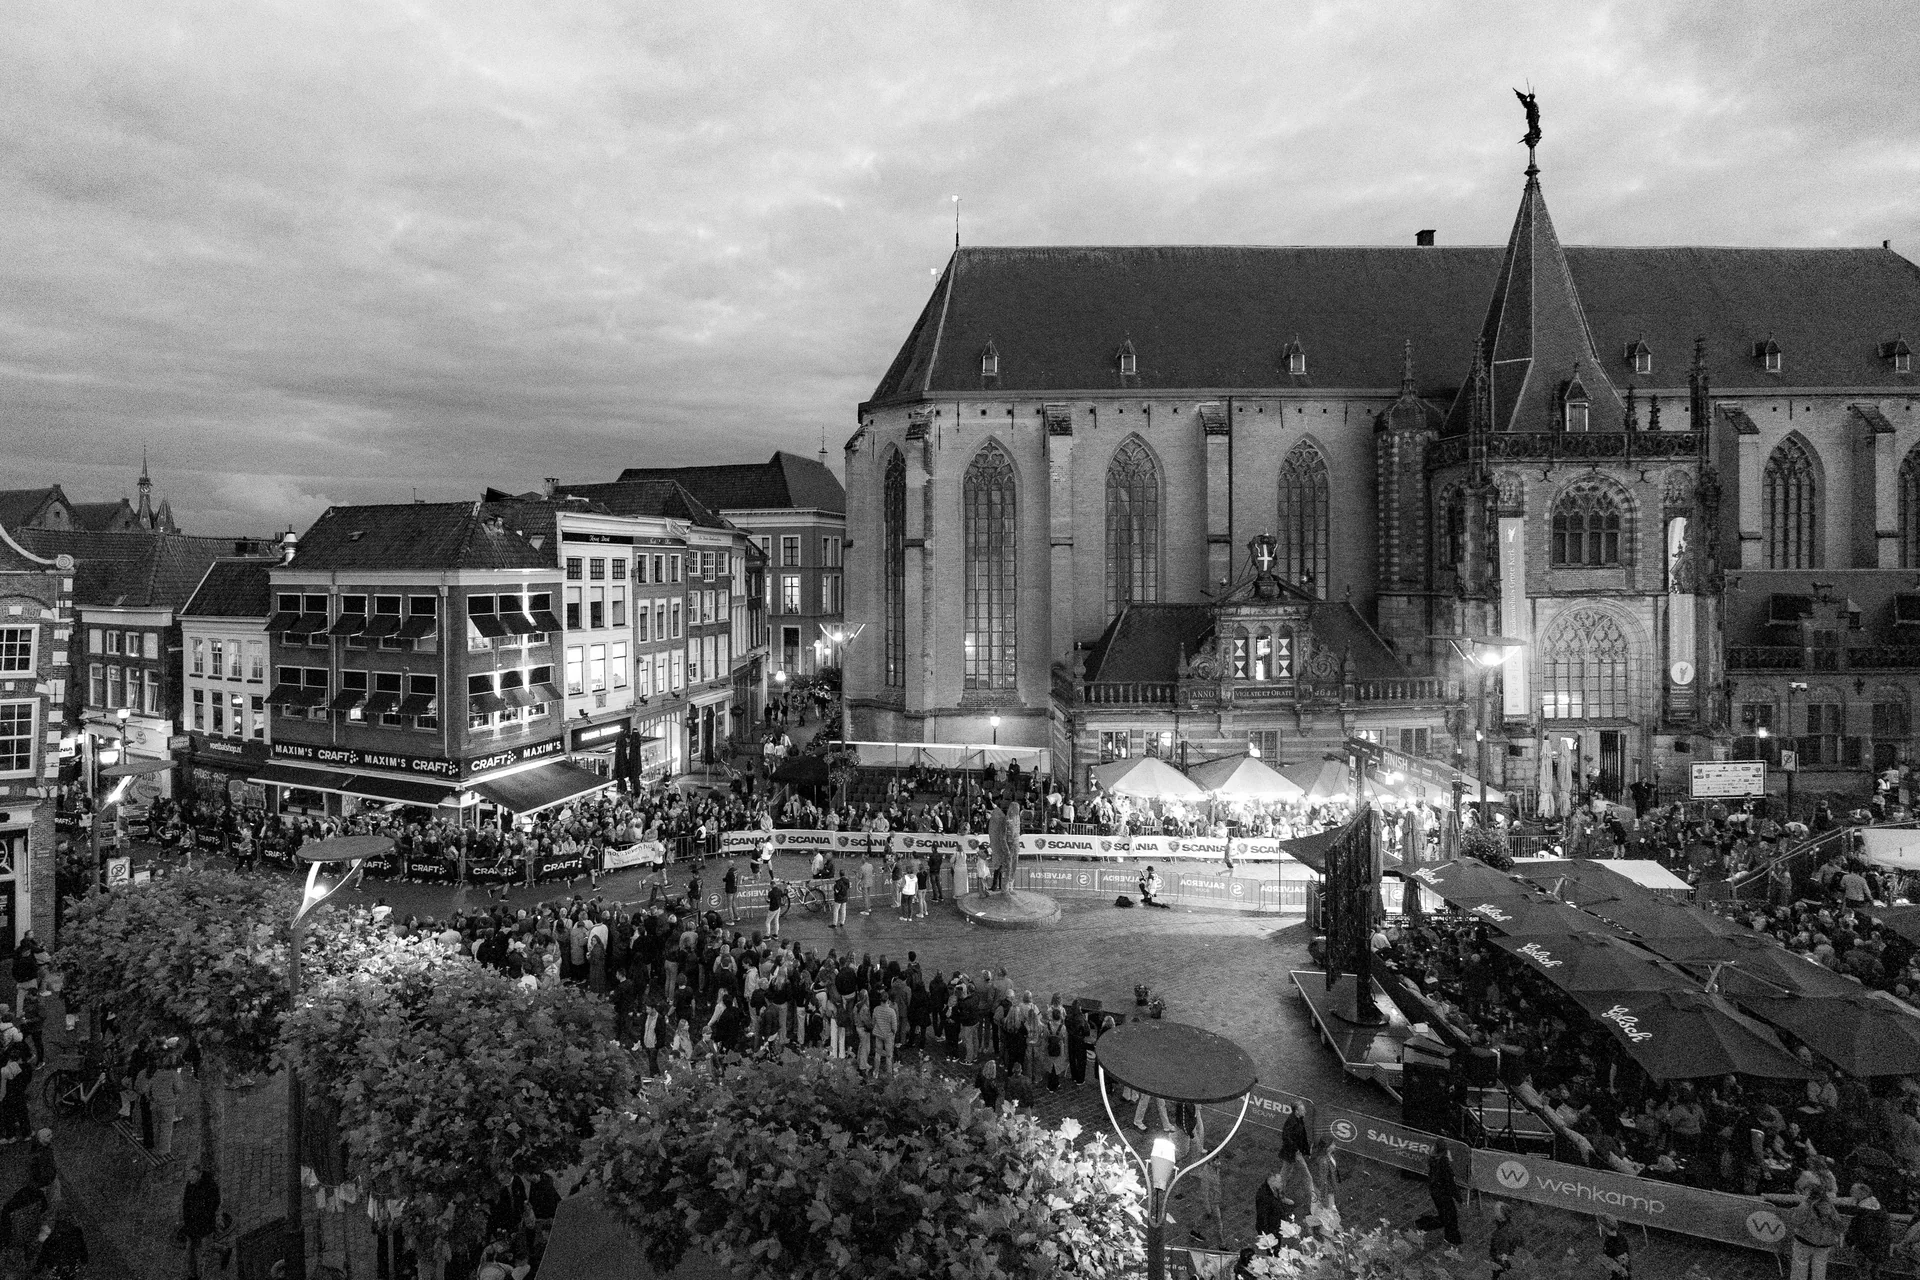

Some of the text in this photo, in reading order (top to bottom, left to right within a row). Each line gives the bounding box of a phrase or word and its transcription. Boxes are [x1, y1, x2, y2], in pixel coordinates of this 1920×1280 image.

[1507, 548, 1515, 565] Kerk
[1192, 690, 1215, 698] ANNO
[1271, 689, 1293, 697] ORATE
[275, 744, 448, 773] MAXIM'S CRAFT MAXIM'S CRAFT
[471, 740, 562, 772] CRAFT MAXIM'S
[1383, 751, 1408, 772] FINISH
[54, 817, 69, 825] RAFT
[788, 836, 831, 845] SCANIA
[1048, 841, 1093, 850] SCANIA
[1250, 845, 1284, 854] SCAN
[411, 864, 439, 873] CRAFT
[473, 867, 508, 876] CRAT
[543, 859, 578, 872] CRAFT
[1601, 1004, 1653, 1043] Grolsch
[1241, 1094, 1293, 1115] LVERD
[1253, 1107, 1276, 1119] BOUW
[1367, 1128, 1435, 1156] SALVER
[1536, 1175, 1665, 1216] wehkamp
